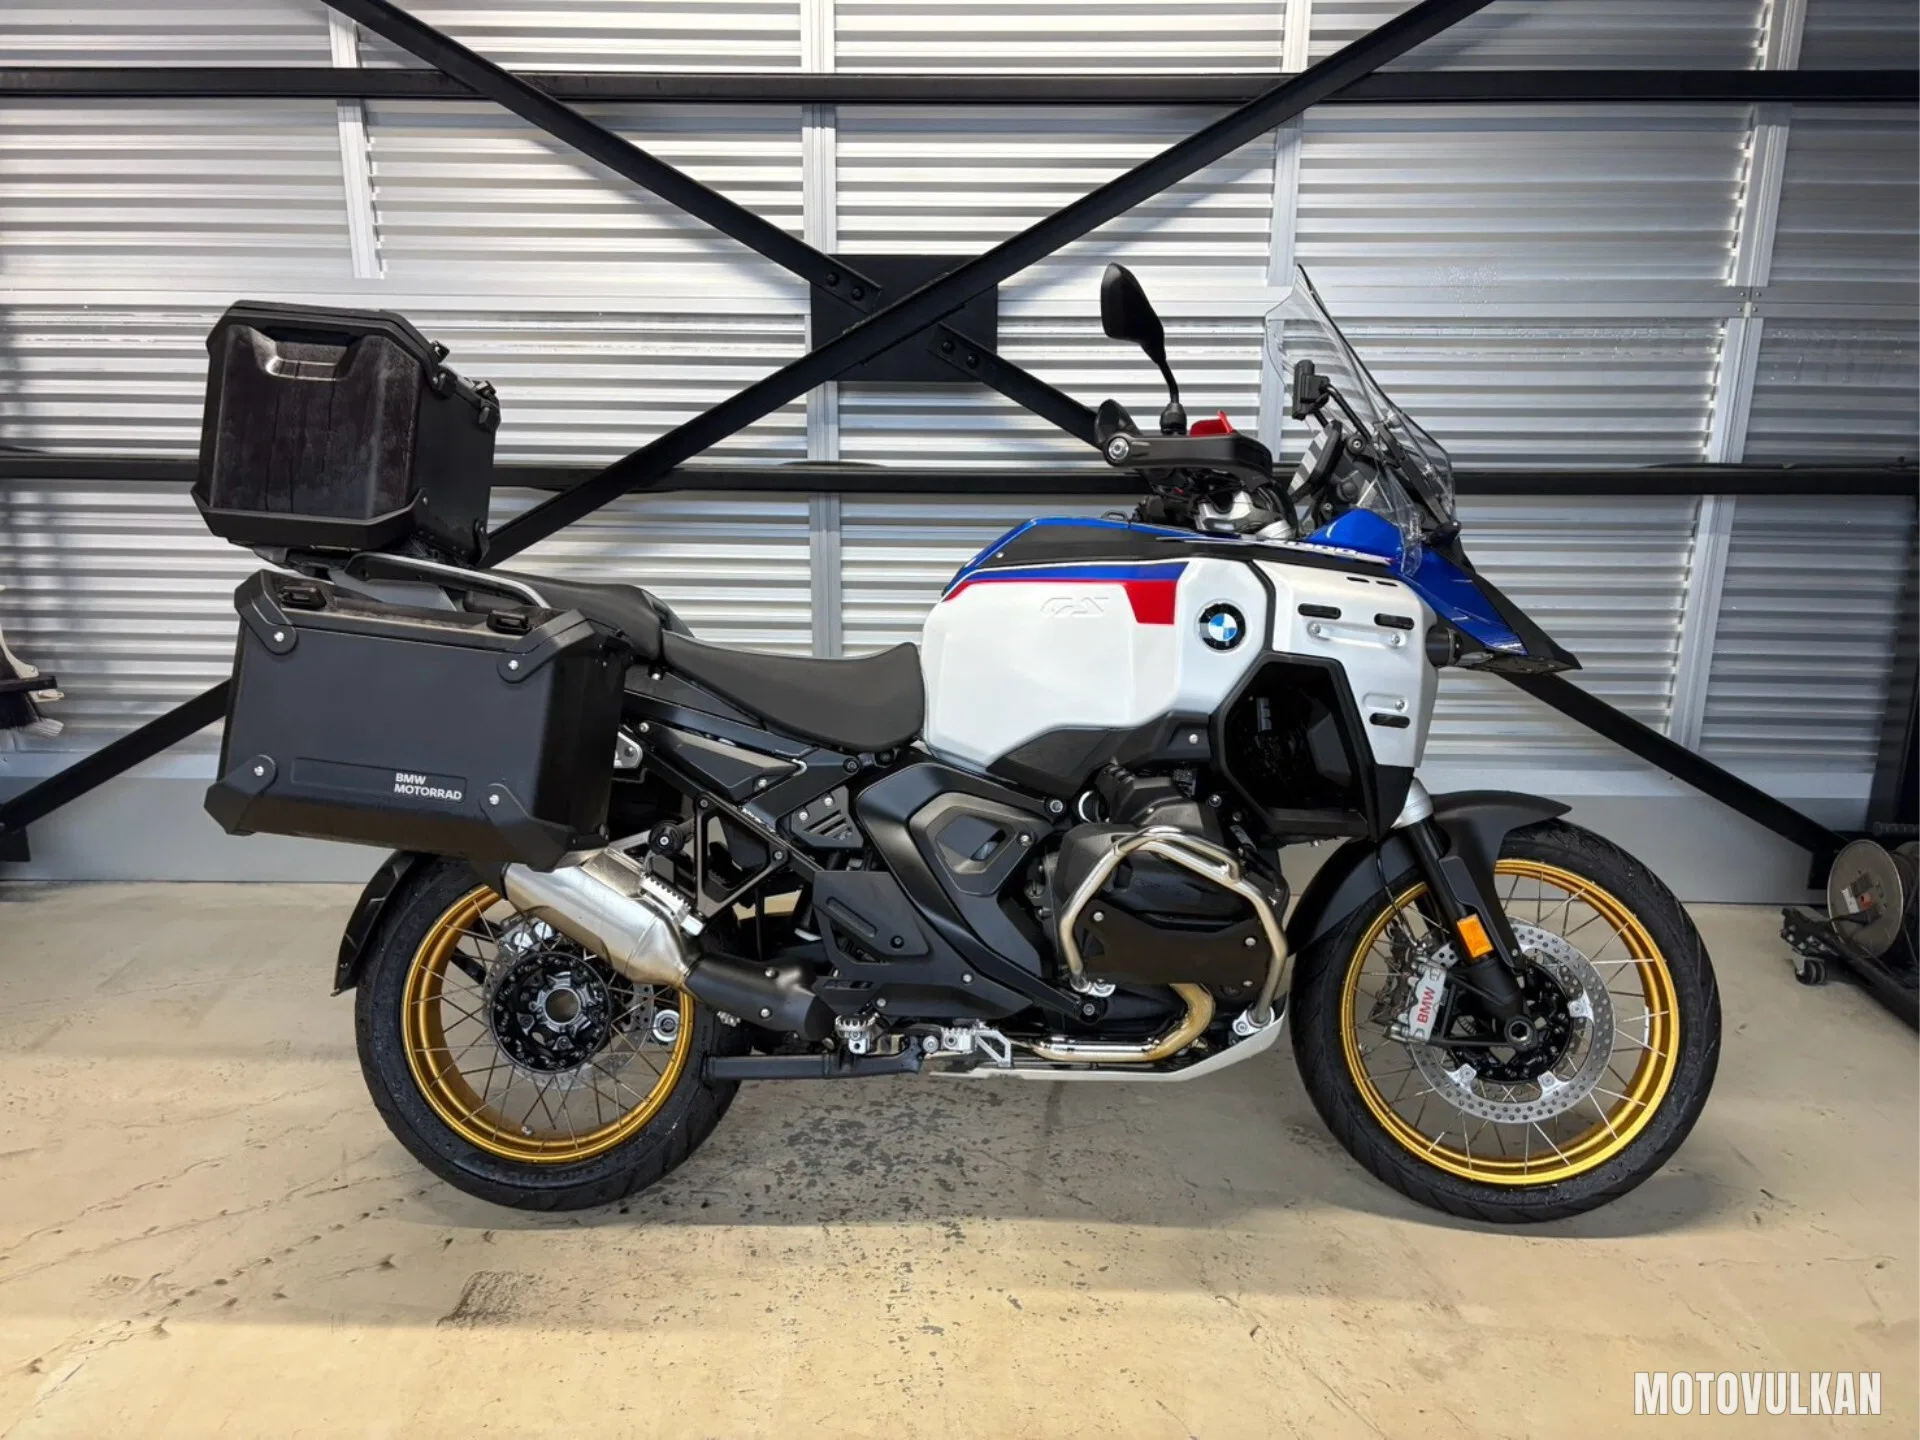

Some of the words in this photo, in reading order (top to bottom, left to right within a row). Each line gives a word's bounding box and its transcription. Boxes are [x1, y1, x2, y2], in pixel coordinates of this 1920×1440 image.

[395, 772, 427, 786] BMW
[393, 783, 462, 800] MOTORRAD
[1417, 986, 1435, 1023] BMW
